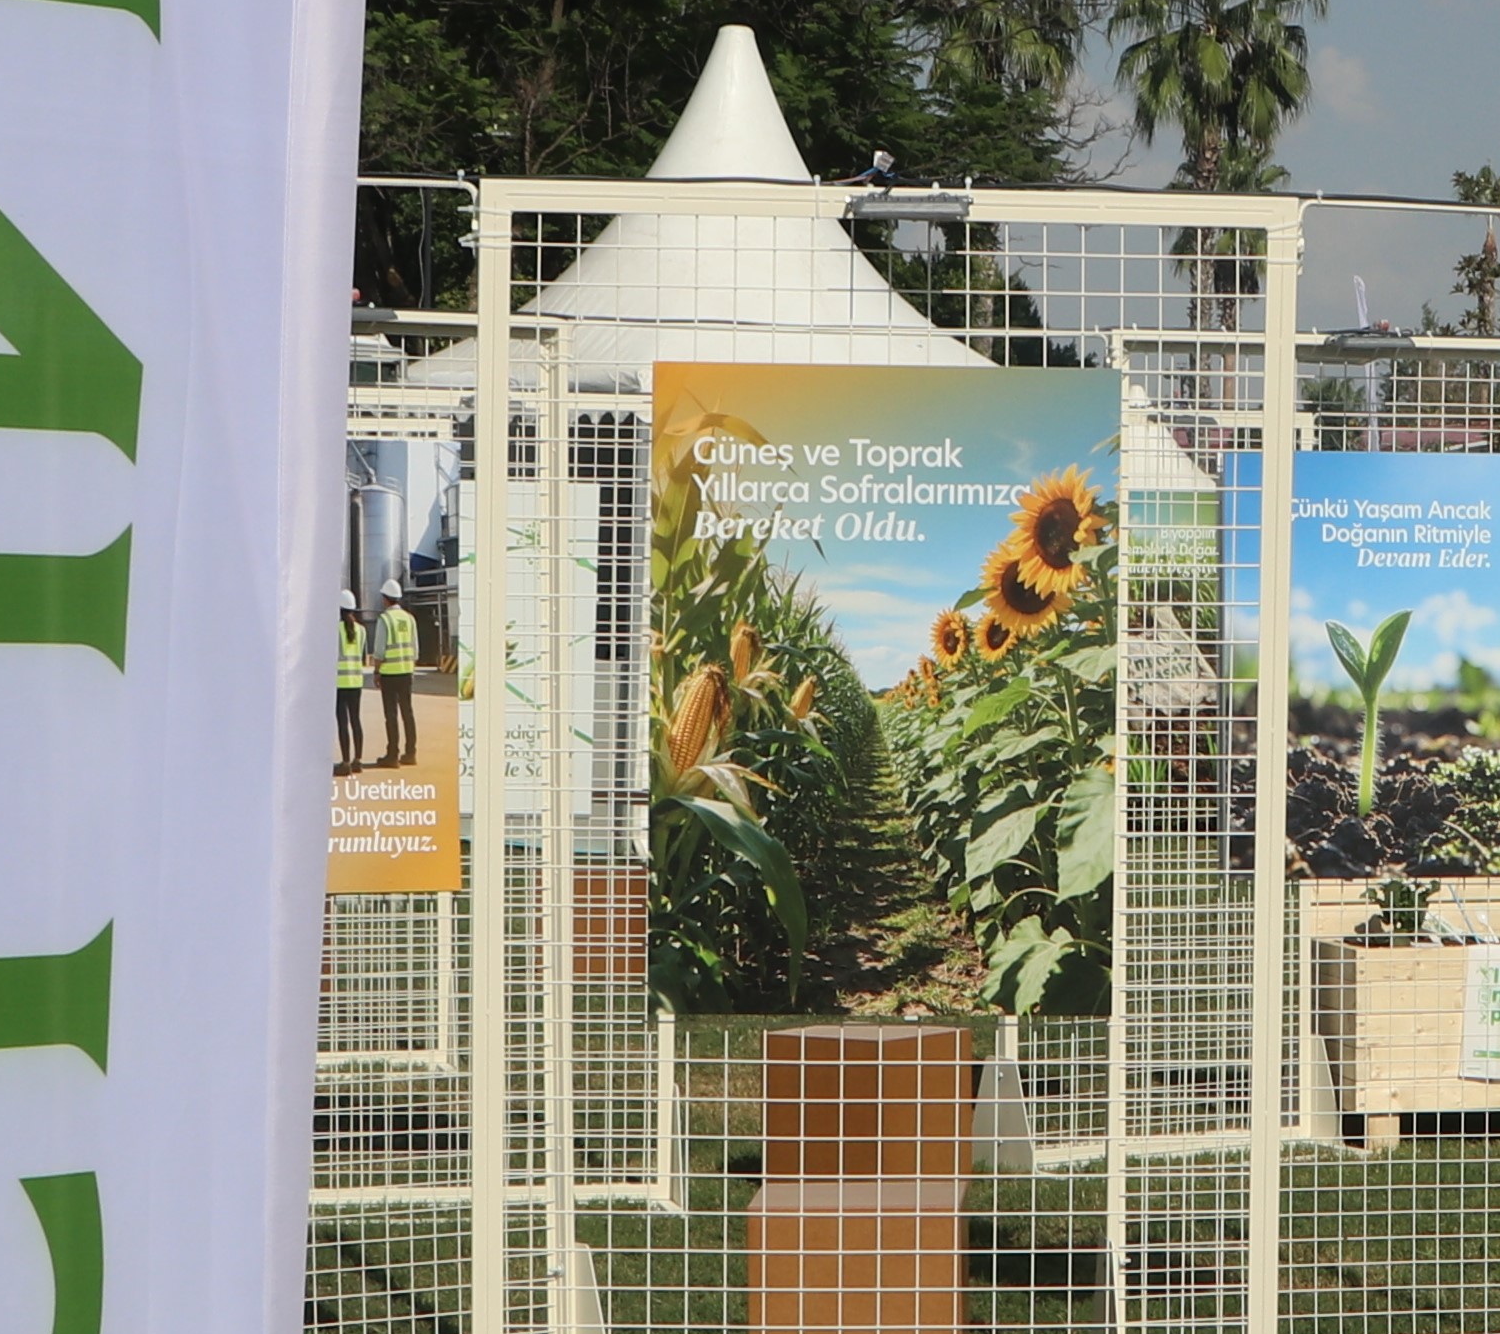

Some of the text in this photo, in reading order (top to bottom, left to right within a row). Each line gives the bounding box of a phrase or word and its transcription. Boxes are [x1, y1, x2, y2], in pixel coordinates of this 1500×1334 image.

[692, 436, 963, 474] Güneş ve Toprak
[692, 472, 1031, 506] Yıllarca Sofralarımıza
[1355, 500, 1423, 523] Yaşam
[1428, 500, 1492, 520] Ancak
[692, 510, 926, 543] Bereket Oldu.
[1322, 523, 1492, 549] Doğanın Ritmiyle
[1357, 548, 1491, 568] Devam Eder.
[345, 775, 436, 800] Üretirken
[331, 806, 436, 831] Dünyasına
[327, 831, 438, 859] rumluyuz.
